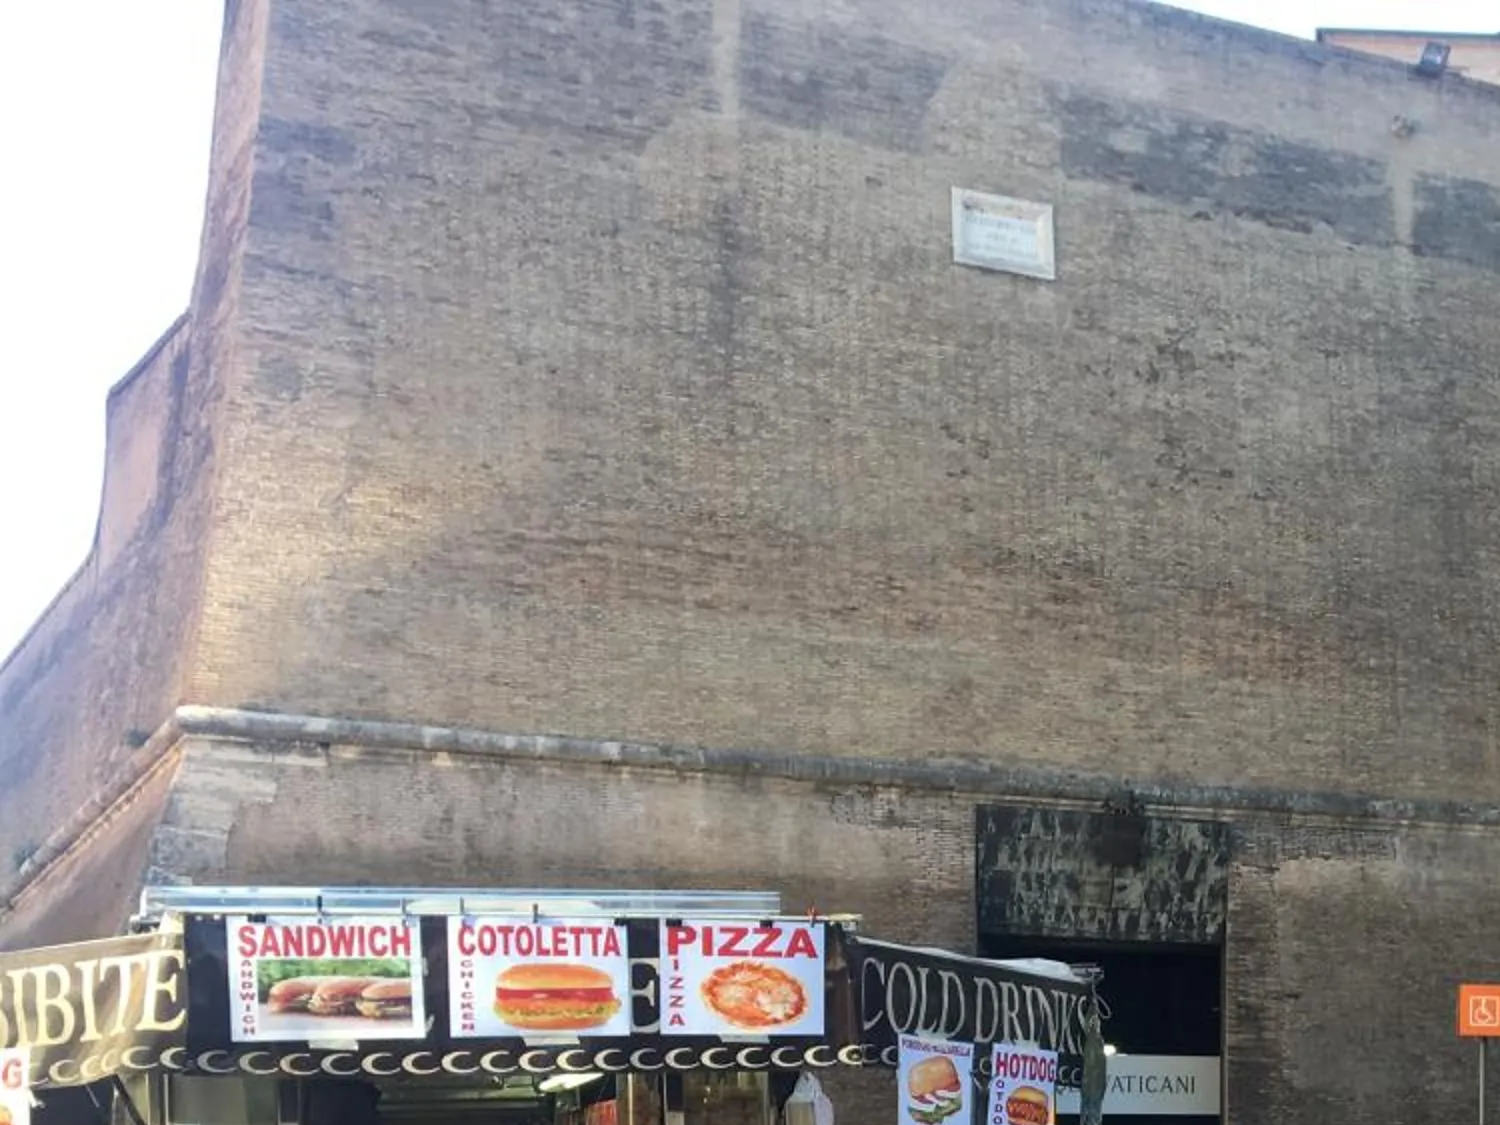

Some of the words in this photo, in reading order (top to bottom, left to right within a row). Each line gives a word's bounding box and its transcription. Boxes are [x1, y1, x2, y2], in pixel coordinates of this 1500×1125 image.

[238, 925, 411, 958] SANDWICH
[458, 924, 621, 957] COTOLETTA
[666, 926, 818, 958] PIZZA
[0, 949, 187, 1048] IBITE
[861, 956, 966, 1037] COLD
[995, 1051, 1057, 1084] HOTDOG
